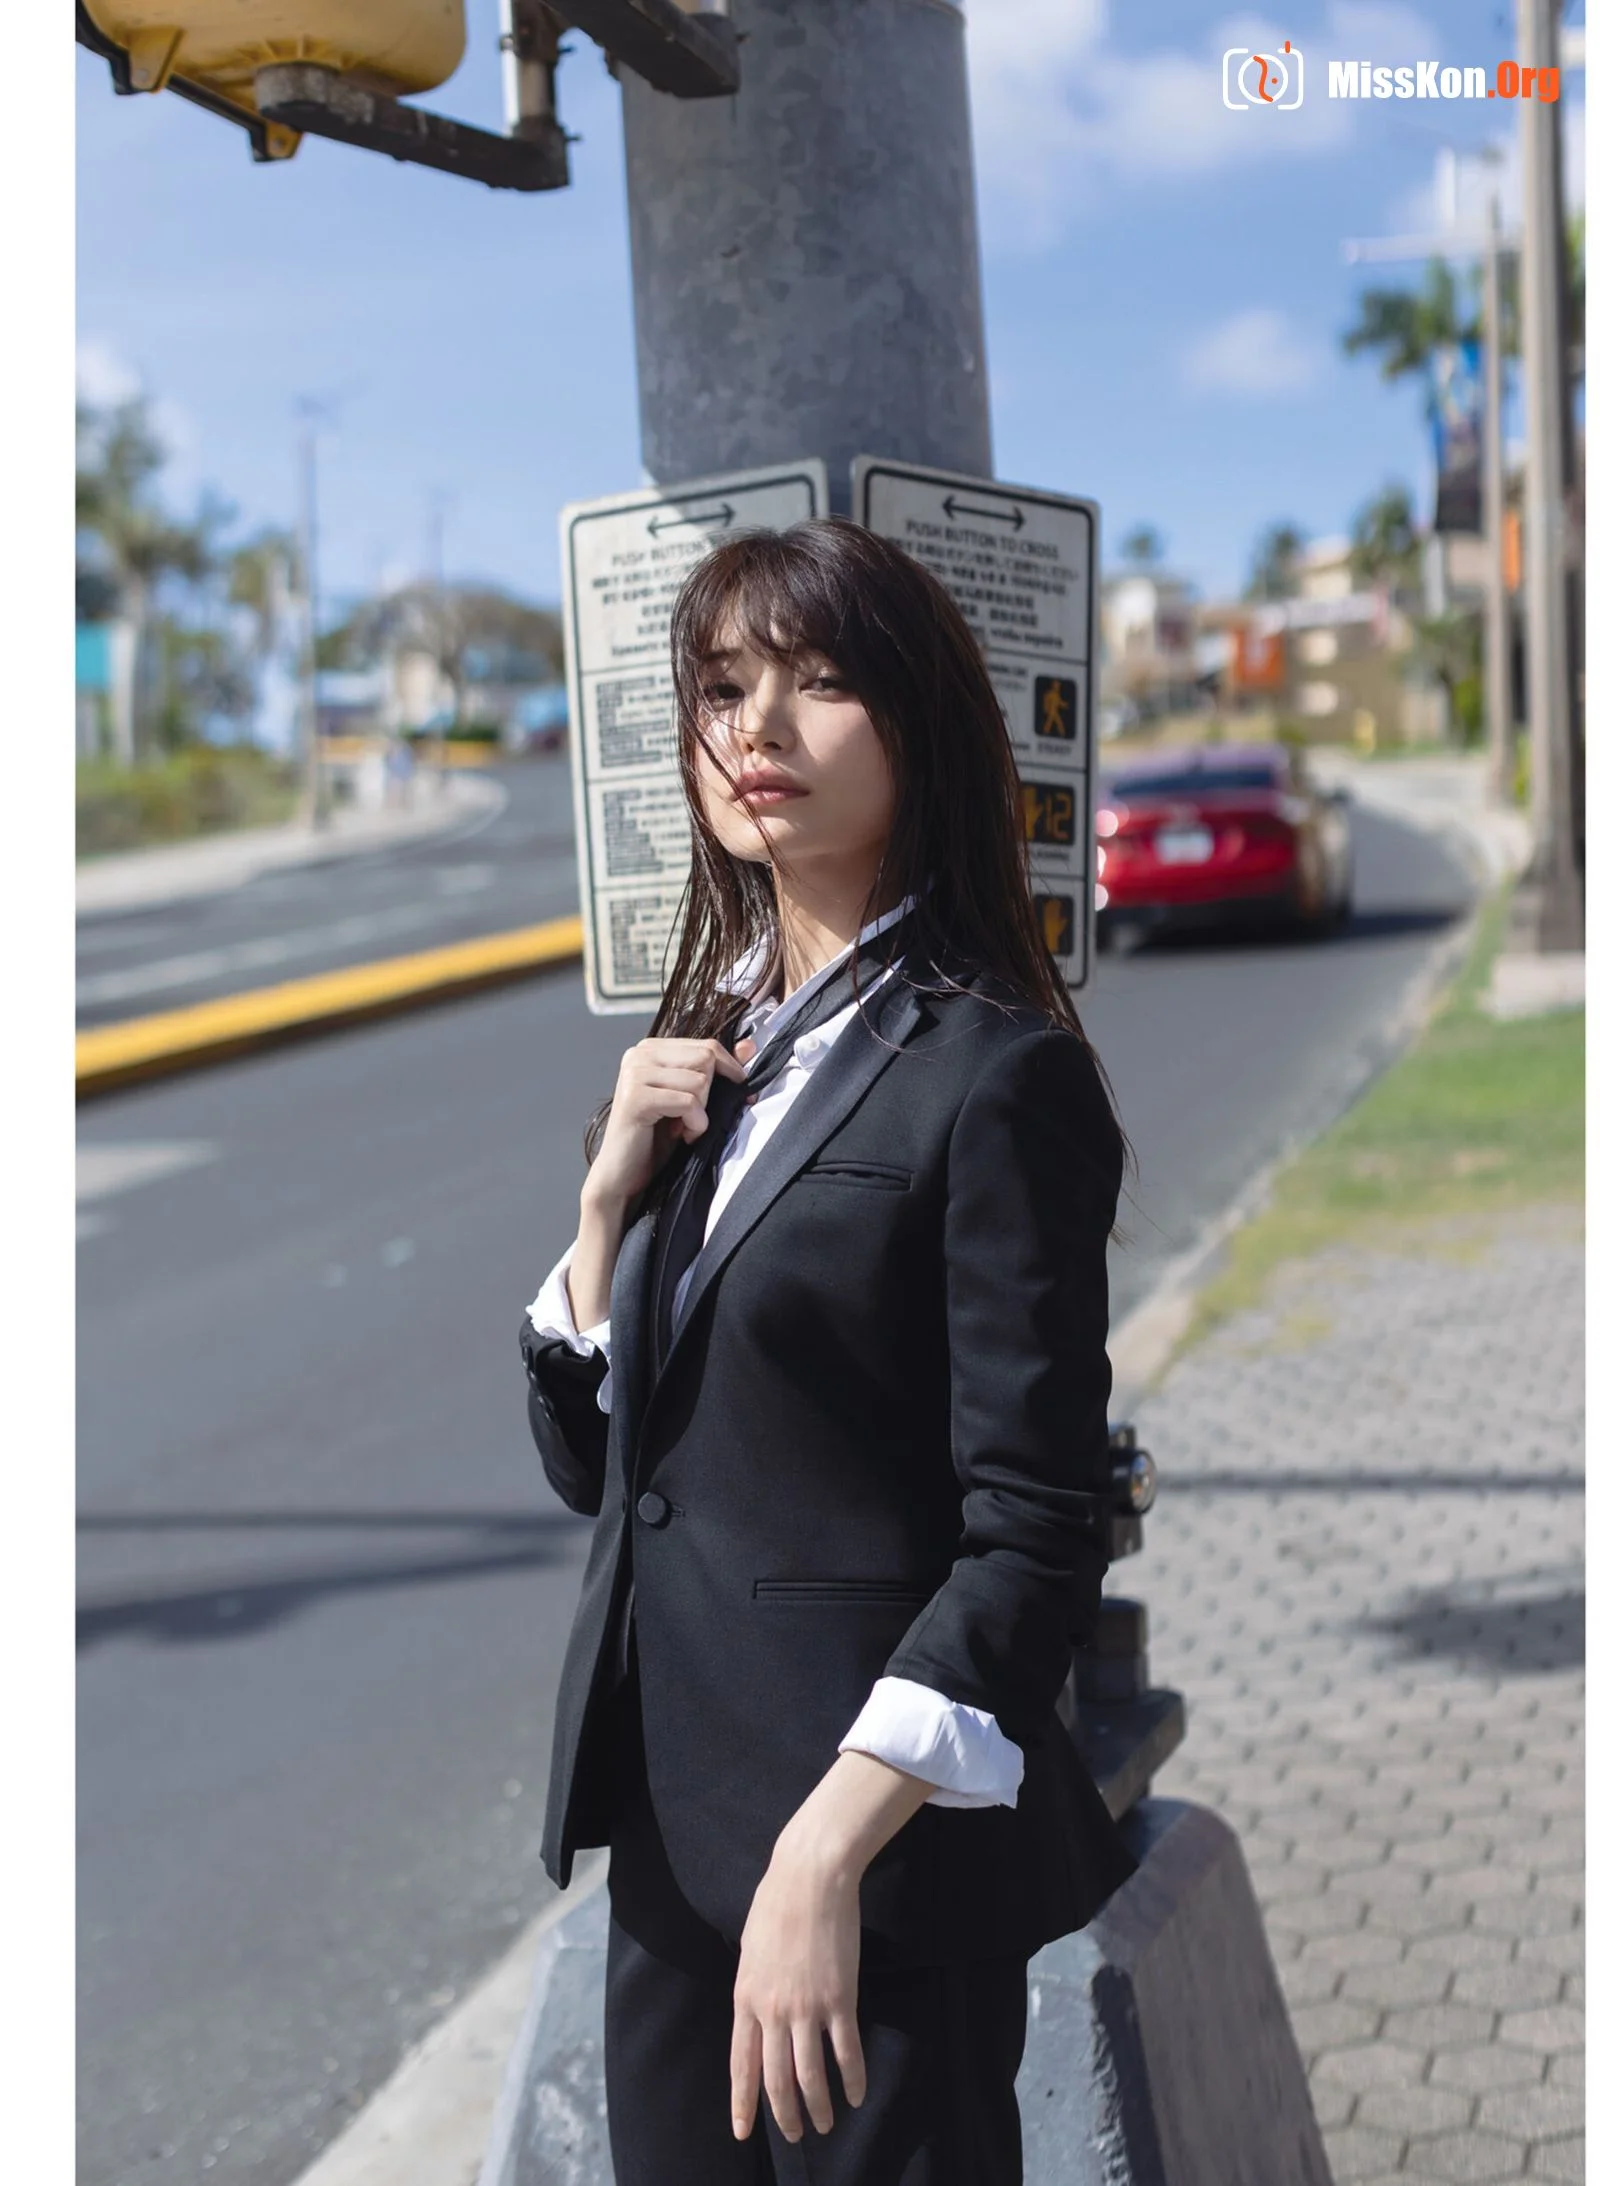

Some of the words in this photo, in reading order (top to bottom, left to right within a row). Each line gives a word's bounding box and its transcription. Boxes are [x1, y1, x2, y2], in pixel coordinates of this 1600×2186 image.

[906, 519, 942, 539] PUSH
[945, 525, 997, 548] BUTTON
[1001, 535, 1016, 551] TO
[1019, 539, 1059, 560] CROSS
